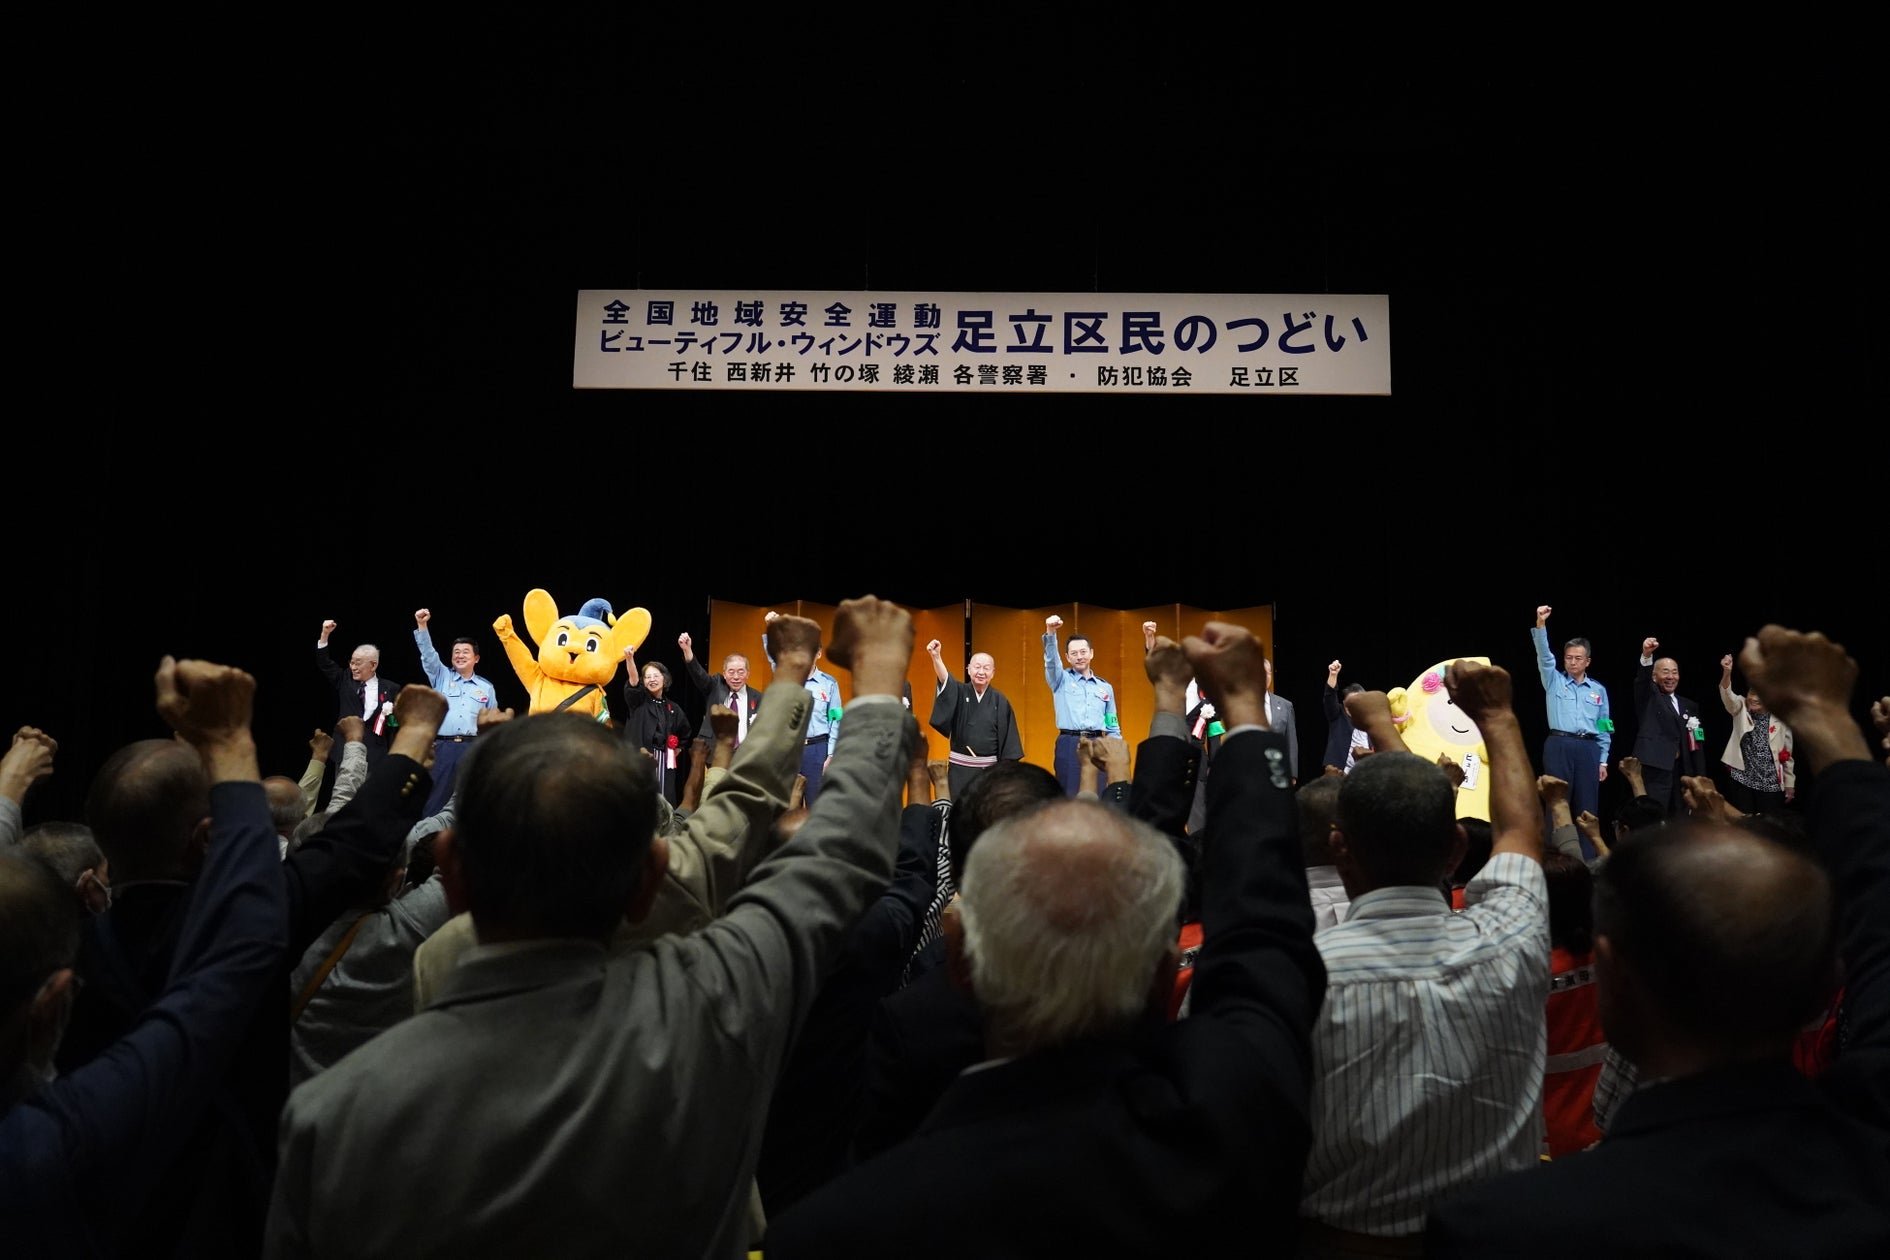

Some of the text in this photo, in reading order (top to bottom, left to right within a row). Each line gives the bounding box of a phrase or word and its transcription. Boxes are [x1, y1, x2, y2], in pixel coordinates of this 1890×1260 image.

[602, 299, 941, 328] 全国地域安全運動
[600, 330, 940, 357] ビューティフル・ウィンドウズ
[951, 309, 1368, 355] 足立区民のつどい
[667, 361, 712, 382] 千住
[726, 361, 796, 383] 西新井
[810, 362, 880, 384] 竹の塚
[893, 363, 940, 385] 綾瀬
[953, 363, 1048, 386] 各警察署
[1097, 365, 1193, 387] 防犯協会
[1229, 366, 1300, 387] 足立区
